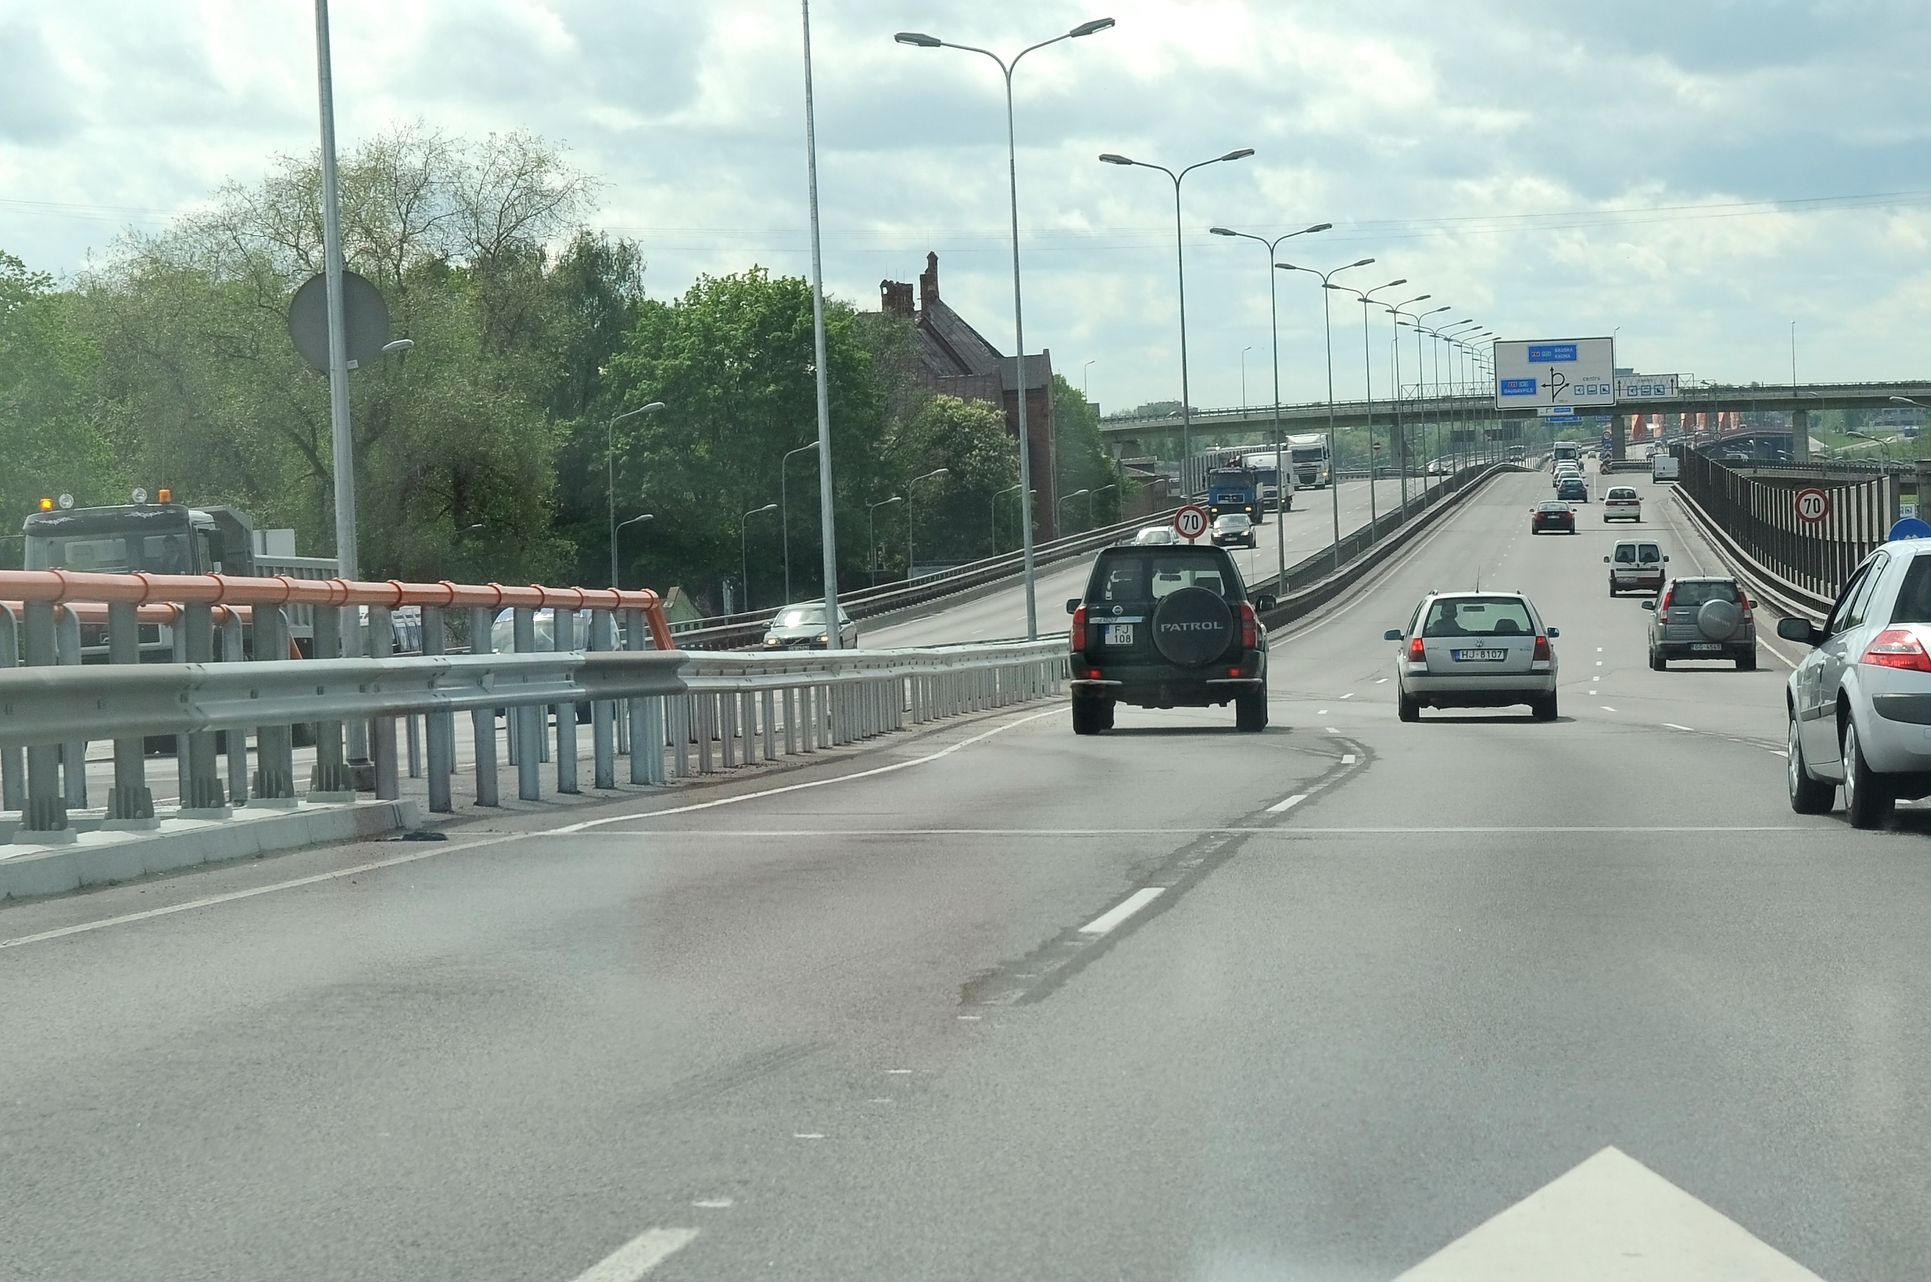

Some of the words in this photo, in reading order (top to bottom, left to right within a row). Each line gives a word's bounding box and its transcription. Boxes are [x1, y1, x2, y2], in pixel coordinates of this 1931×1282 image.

[1804, 498, 1820, 514] 70
[1183, 515, 1199, 531] 70
[1114, 625, 1129, 634] FJ
[1160, 622, 1223, 632] PATROL
[1114, 634, 1131, 644] 108
[1461, 650, 1503, 659] HJ-8107
